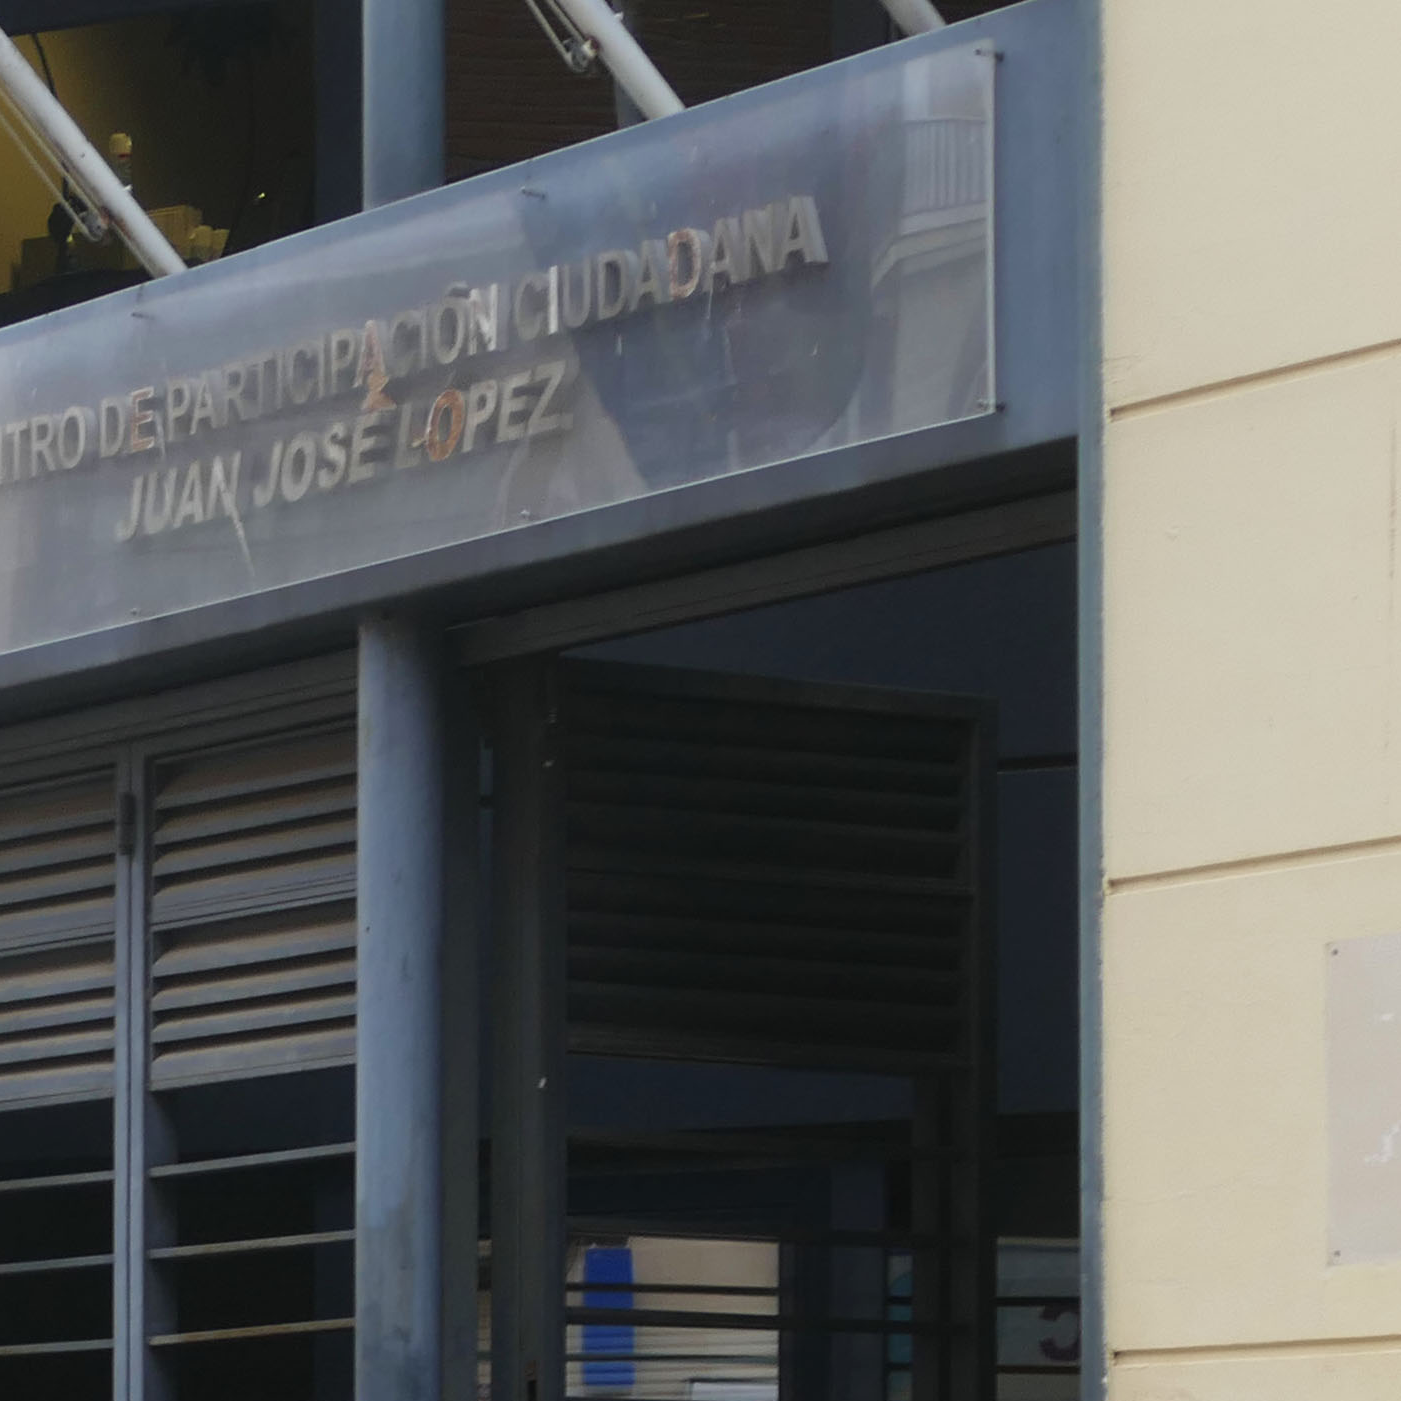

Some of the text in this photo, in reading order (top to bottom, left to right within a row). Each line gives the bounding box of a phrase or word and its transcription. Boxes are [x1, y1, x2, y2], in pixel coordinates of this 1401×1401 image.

[99, 385, 156, 459] DE
[514, 195, 830, 341] CIUDADANA
[115, 449, 243, 542] JUAN
